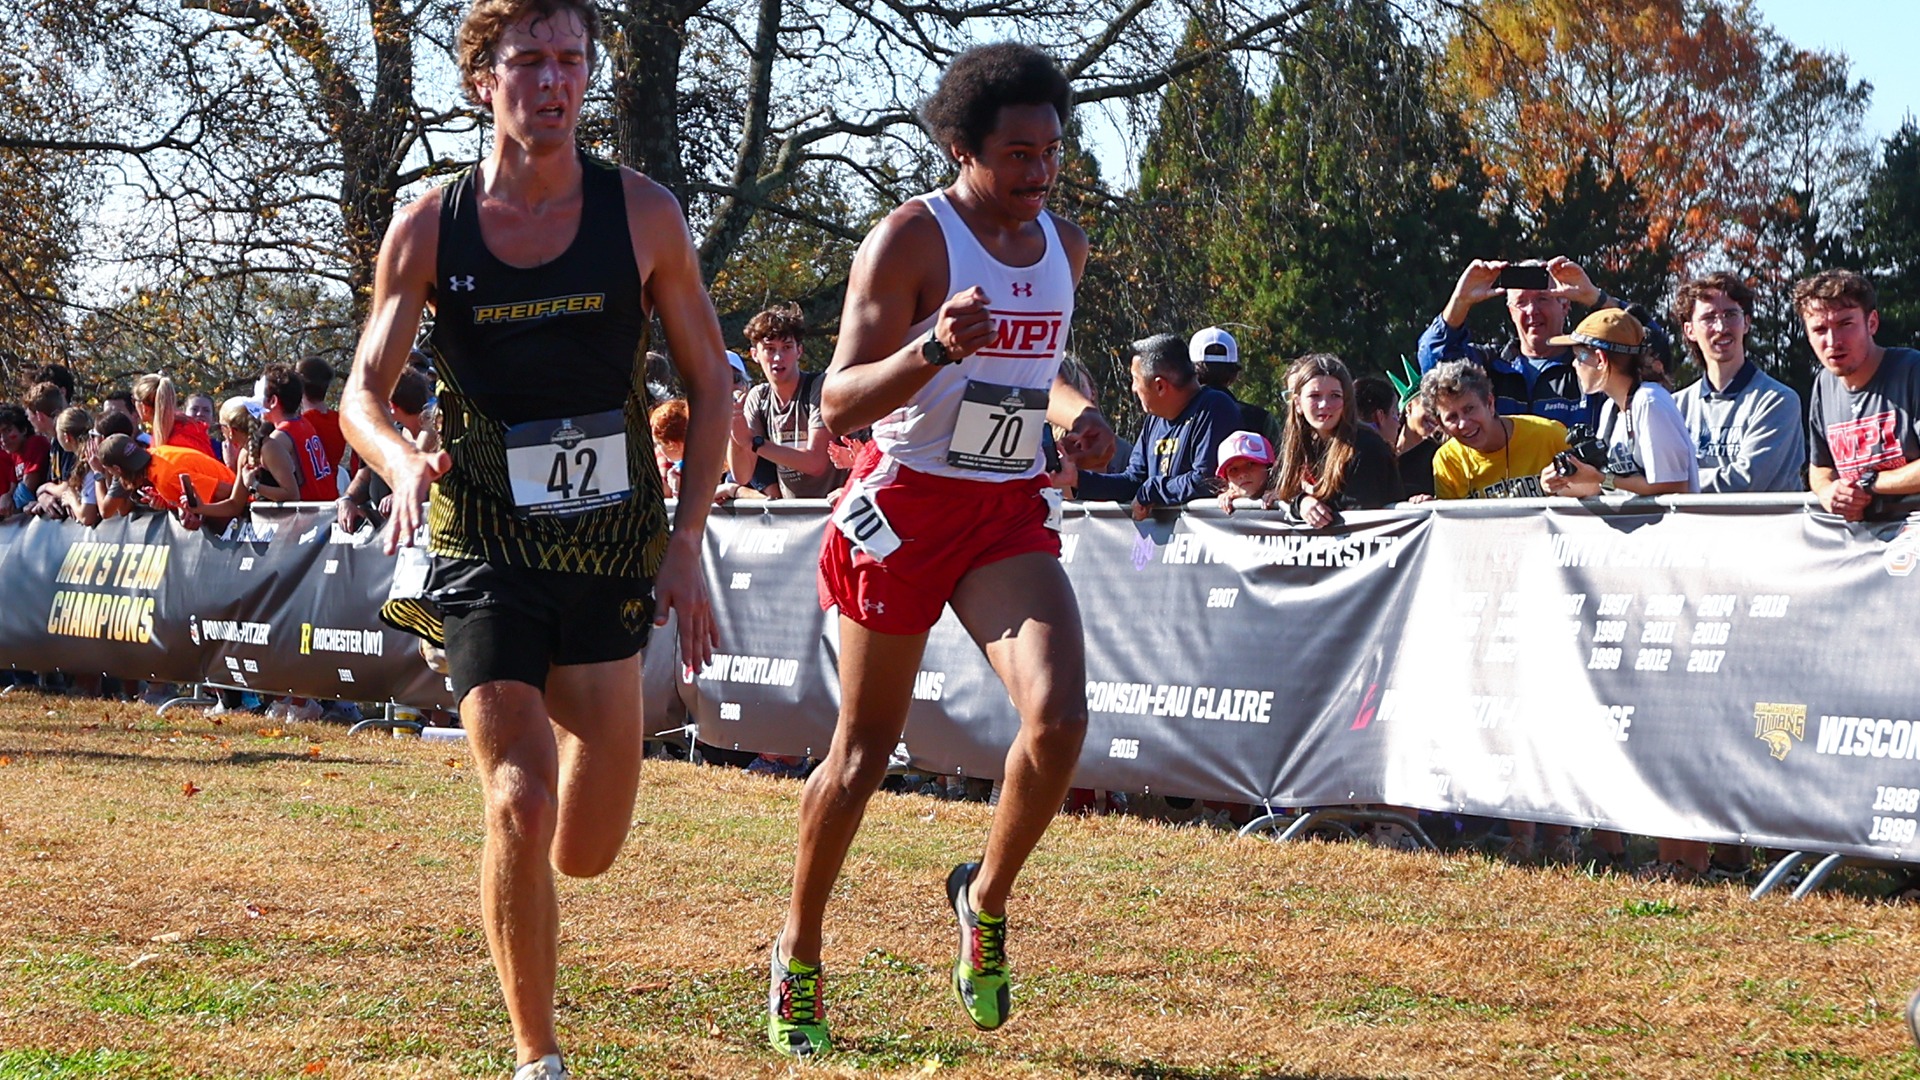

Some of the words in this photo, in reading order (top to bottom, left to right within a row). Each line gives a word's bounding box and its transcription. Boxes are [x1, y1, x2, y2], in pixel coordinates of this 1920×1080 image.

[475, 294, 604, 323] PFEIFFER
[986, 319, 1062, 350] WPI
[980, 413, 1024, 458] 70
[1828, 418, 1901, 464] WPI
[305, 435, 331, 480] 12
[547, 448, 600, 499] 42
[842, 495, 883, 541] 70
[737, 528, 789, 554] LUTHER
[55, 542, 120, 586] MEN'S
[112, 543, 170, 590] TEAM
[1207, 588, 1239, 608] 2007
[1597, 594, 1633, 616] 1997
[1697, 594, 1737, 617] 2014
[1749, 595, 1790, 618] 2018
[47, 590, 155, 643] CHAMPIONS
[313, 628, 362, 653] ROCHESTER
[363, 630, 383, 657] (NY)
[1593, 620, 1627, 642] 1998
[1641, 621, 1677, 643] 2011
[1691, 622, 1731, 645] 2016
[730, 655, 799, 687] CORTLAND
[1588, 647, 1622, 670] 1999
[1635, 648, 1672, 671] 2012
[1687, 650, 1726, 673] 2017
[1085, 681, 1192, 718] CONSIN-EAU
[1193, 687, 1275, 724] CLAIRE
[1754, 711, 1806, 741] TITANS
[1109, 738, 1139, 760] 2015
[1872, 785, 1920, 813] 1988
[1869, 816, 1917, 844] 1989
